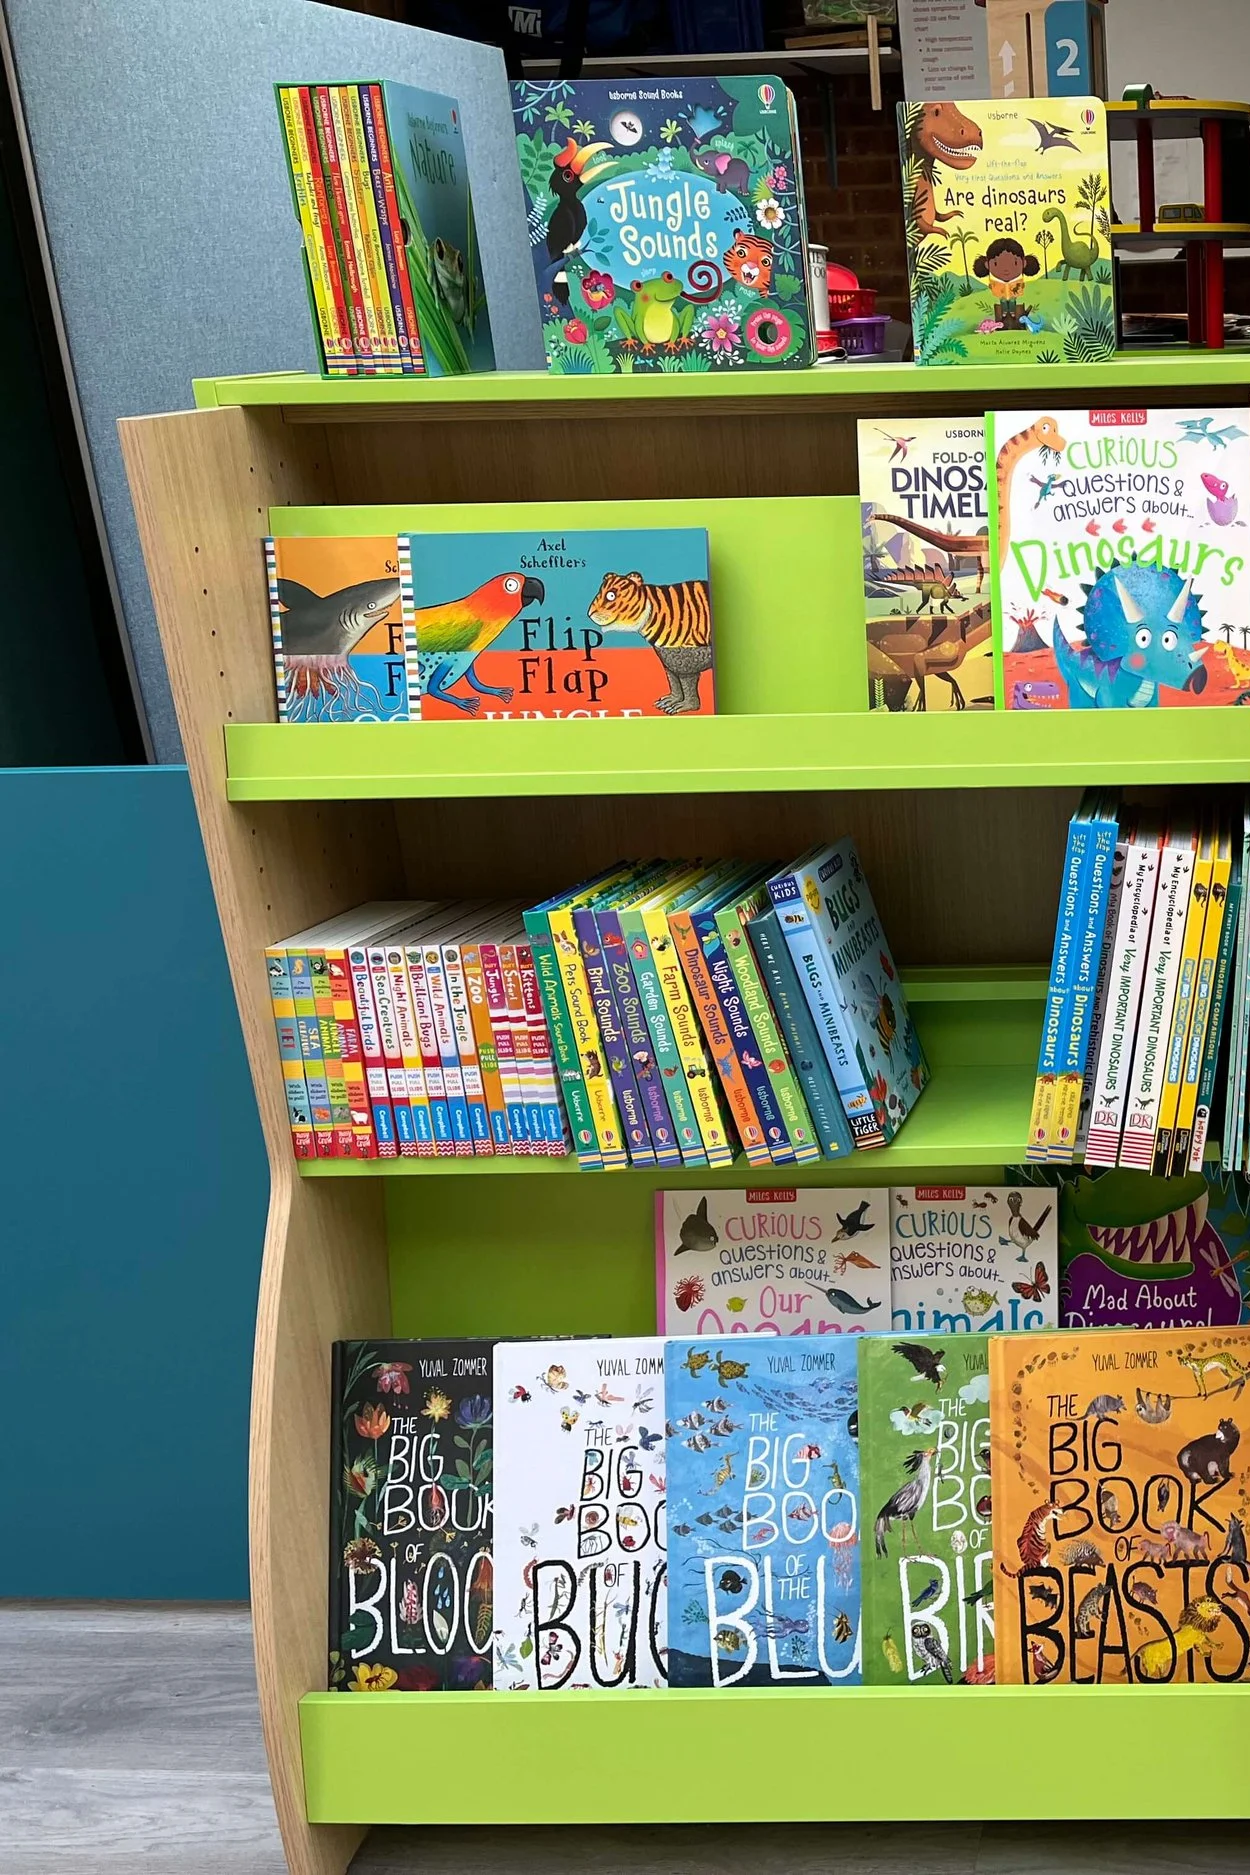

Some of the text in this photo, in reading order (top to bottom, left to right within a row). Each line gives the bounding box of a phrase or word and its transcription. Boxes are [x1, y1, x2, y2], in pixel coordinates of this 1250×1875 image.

[1056, 39, 1080, 76] 2
[638, 90, 683, 99] Sound Books
[409, 138, 456, 186] Nature
[608, 181, 710, 223] Jungle
[944, 185, 1066, 208] Are dinosaurs
[985, 211, 1028, 232] real?
[619, 224, 719, 266] Sounds
[1173, 479, 1184, 497] &
[1054, 496, 1136, 523] answers
[537, 538, 567, 552] Axel
[1011, 535, 1244, 602] Dinosaurs
[519, 616, 603, 661] Flip
[519, 655, 609, 702] Flap
[1062, 856, 1082, 918] Questions
[1052, 932, 1072, 984] Answers
[466, 976, 482, 1004] Zoo
[485, 969, 500, 1003] Jungle
[504, 969, 518, 1000] Safari
[520, 969, 536, 1010] Kittens
[1049, 985, 1071, 994] about
[355, 974, 374, 1052] Beautiful Birds
[587, 966, 619, 1043] Bird Sounds
[661, 965, 696, 1048] Farm Sounds
[733, 954, 777, 1055] Woodland Sounds
[1042, 996, 1064, 1068] Dinosaurs
[1104, 974, 1133, 1092] IMPORTANT DINOSAURS
[760, 1285, 813, 1318] Our
[1082, 1284, 1197, 1310] Mad About
[419, 1358, 488, 1377] YUVAL ZOMMER
[1092, 1352, 1159, 1371] YUVAL ZOMMER
[1047, 1394, 1078, 1418] THE
[391, 1417, 418, 1435] THE
[387, 1433, 445, 1484] BIG
[1048, 1418, 1123, 1476] BIG
[1050, 1475, 1230, 1540] BOOK
[1114, 1536, 1140, 1563] OF
